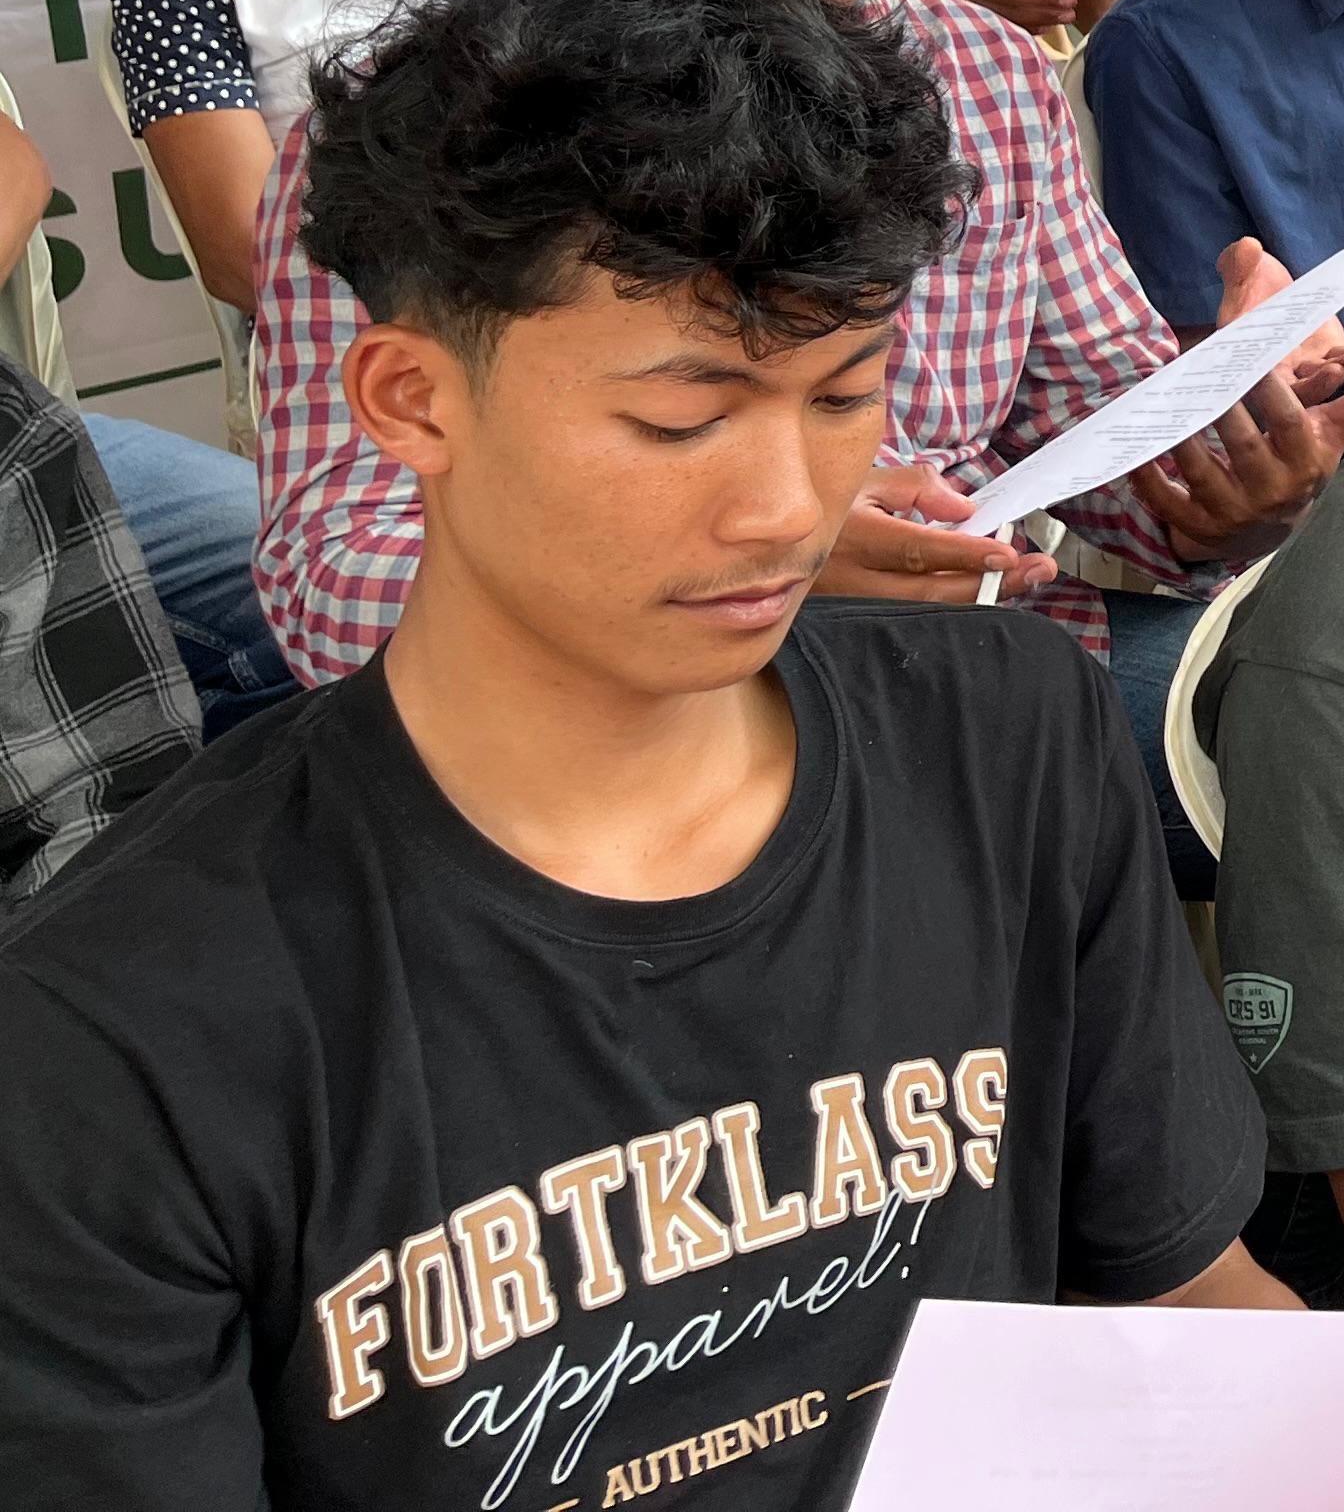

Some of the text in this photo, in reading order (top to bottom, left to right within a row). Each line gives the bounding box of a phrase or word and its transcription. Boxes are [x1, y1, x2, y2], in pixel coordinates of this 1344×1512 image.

[1228, 999, 1277, 1020] CRS 91
[316, 1047, 1008, 1423] FORTKLASS
[602, 1390, 829, 1509] AUTHENTIC
